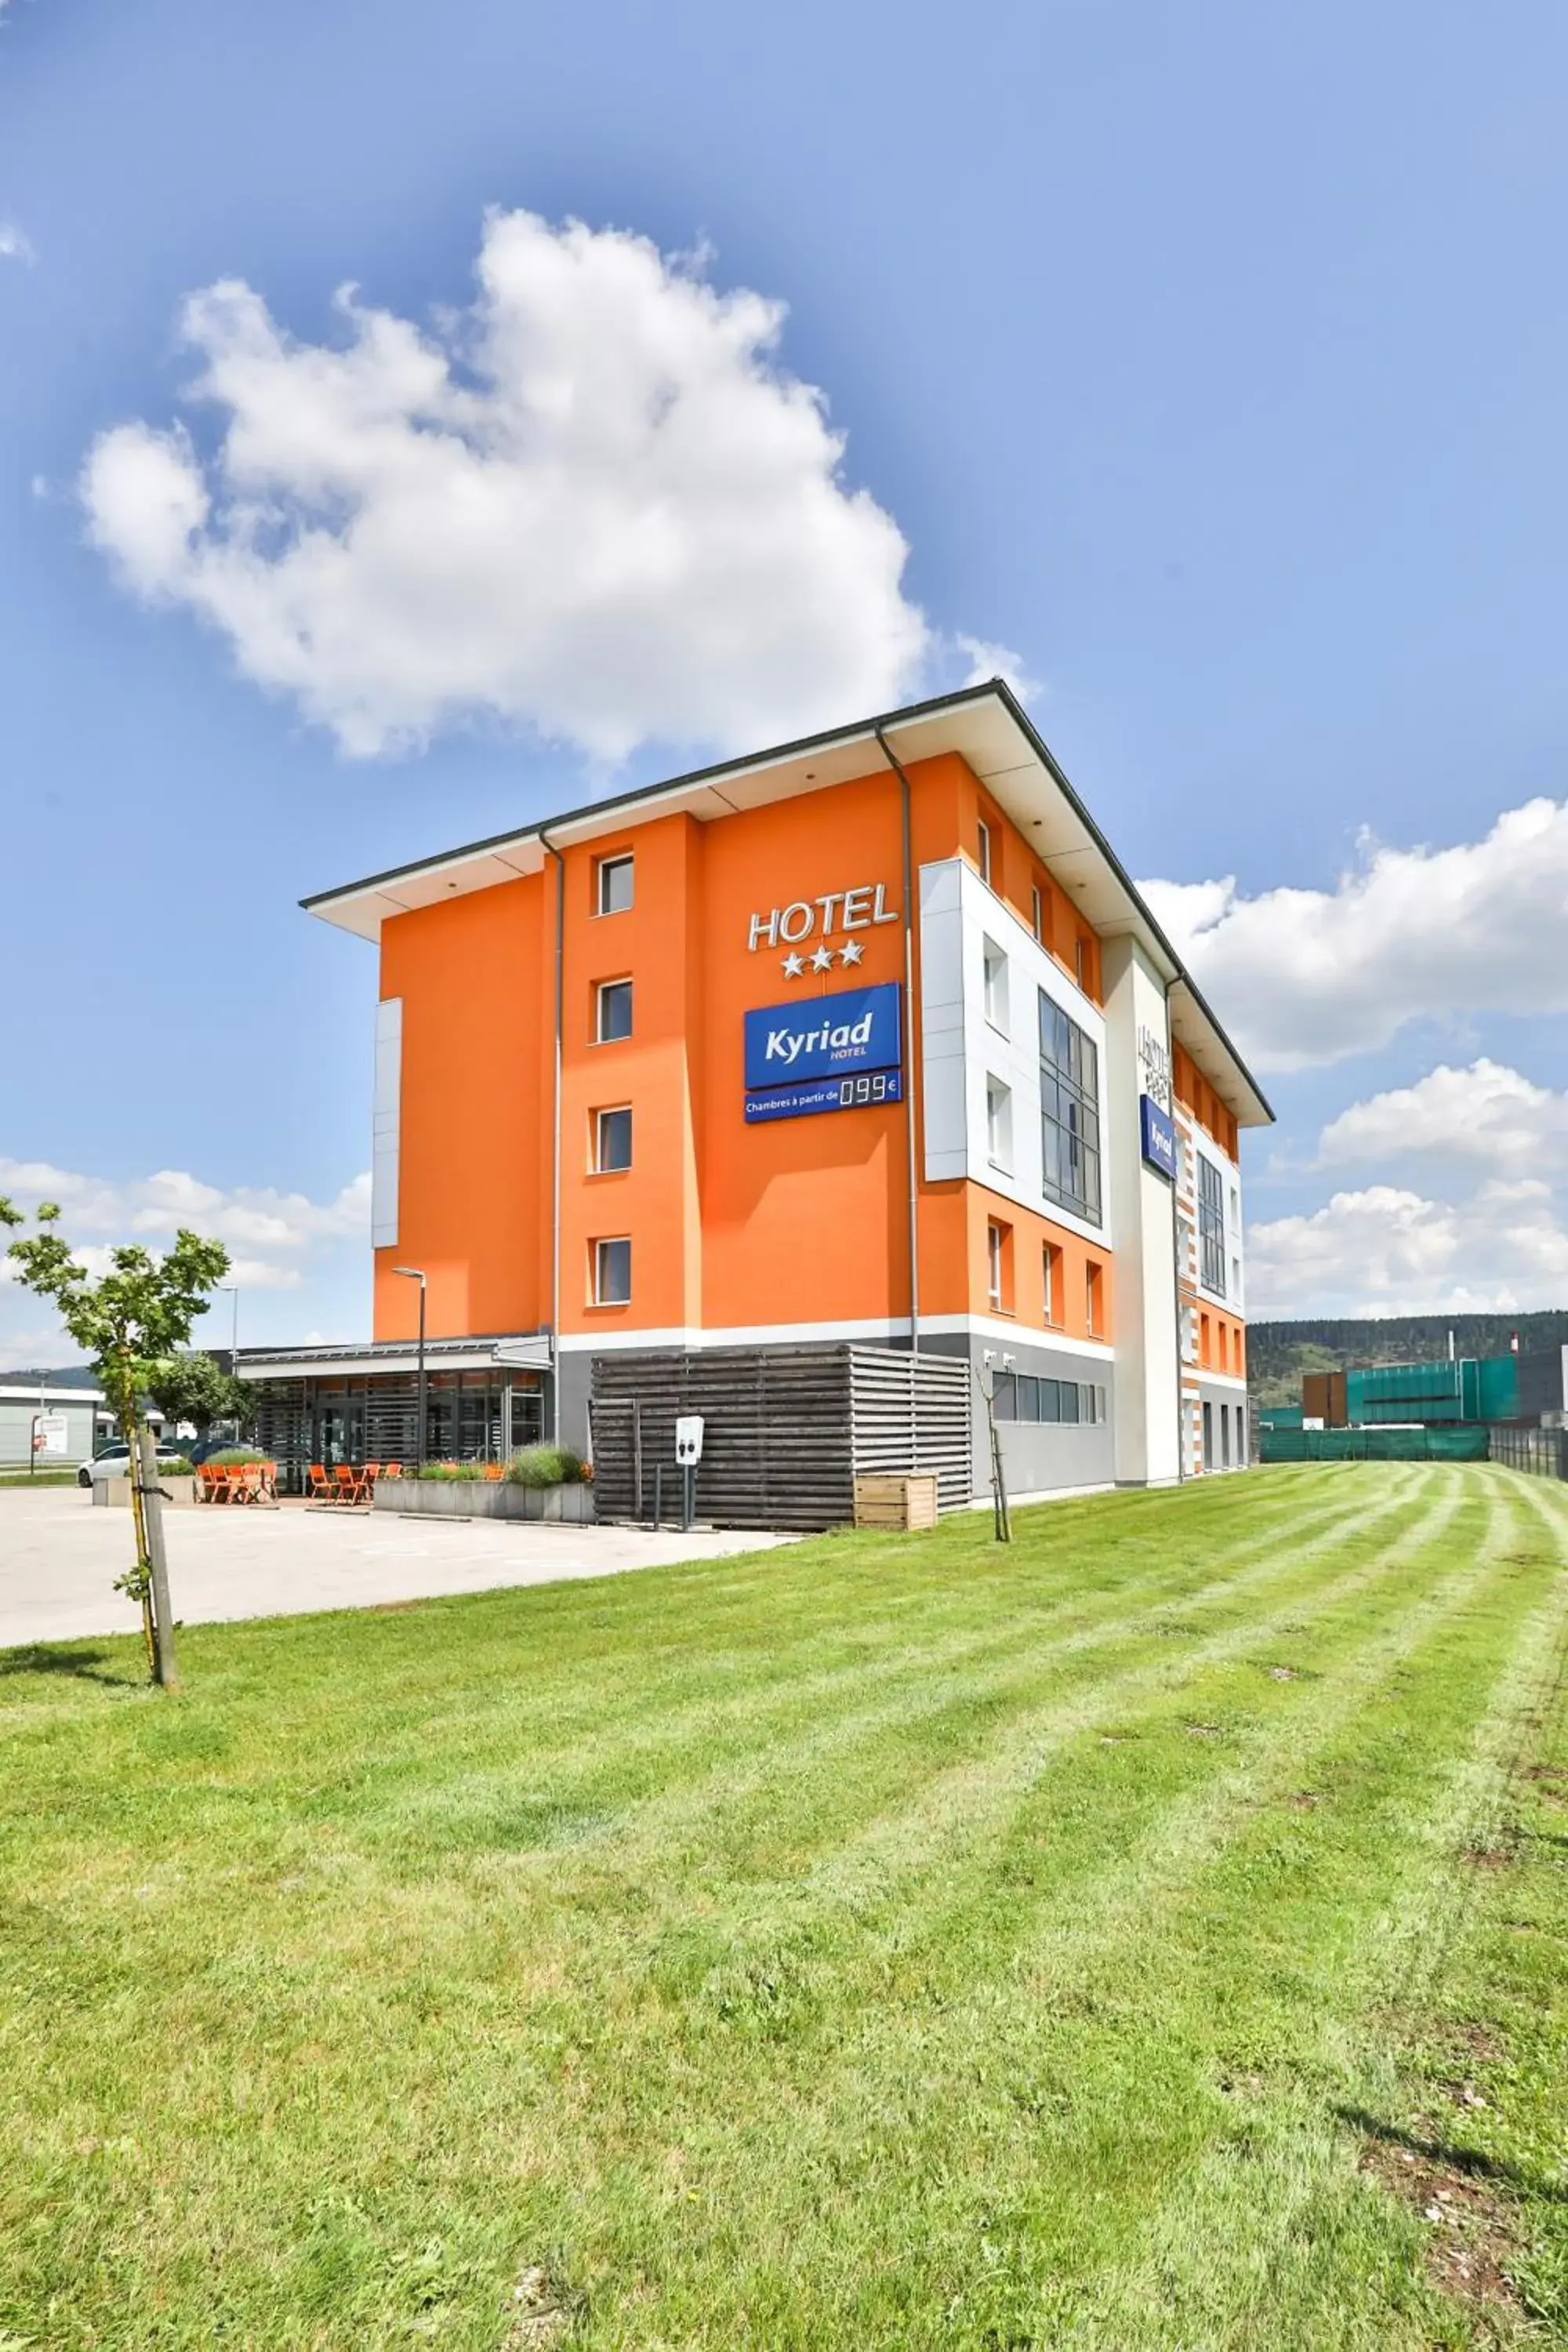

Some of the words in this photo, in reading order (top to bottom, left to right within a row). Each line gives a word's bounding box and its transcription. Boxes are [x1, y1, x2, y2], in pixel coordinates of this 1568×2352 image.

[748, 883, 899, 952] HOTEL
[765, 1012, 873, 1065] Kyriad
[830, 1046, 866, 1061] HOTEL
[746, 1099, 791, 1112] Chambres
[792, 1094, 798, 1106] à
[799, 1092, 825, 1106] partir
[826, 1091, 838, 1101] de
[840, 1075, 886, 1105] 099
[888, 1079, 898, 1091] €
